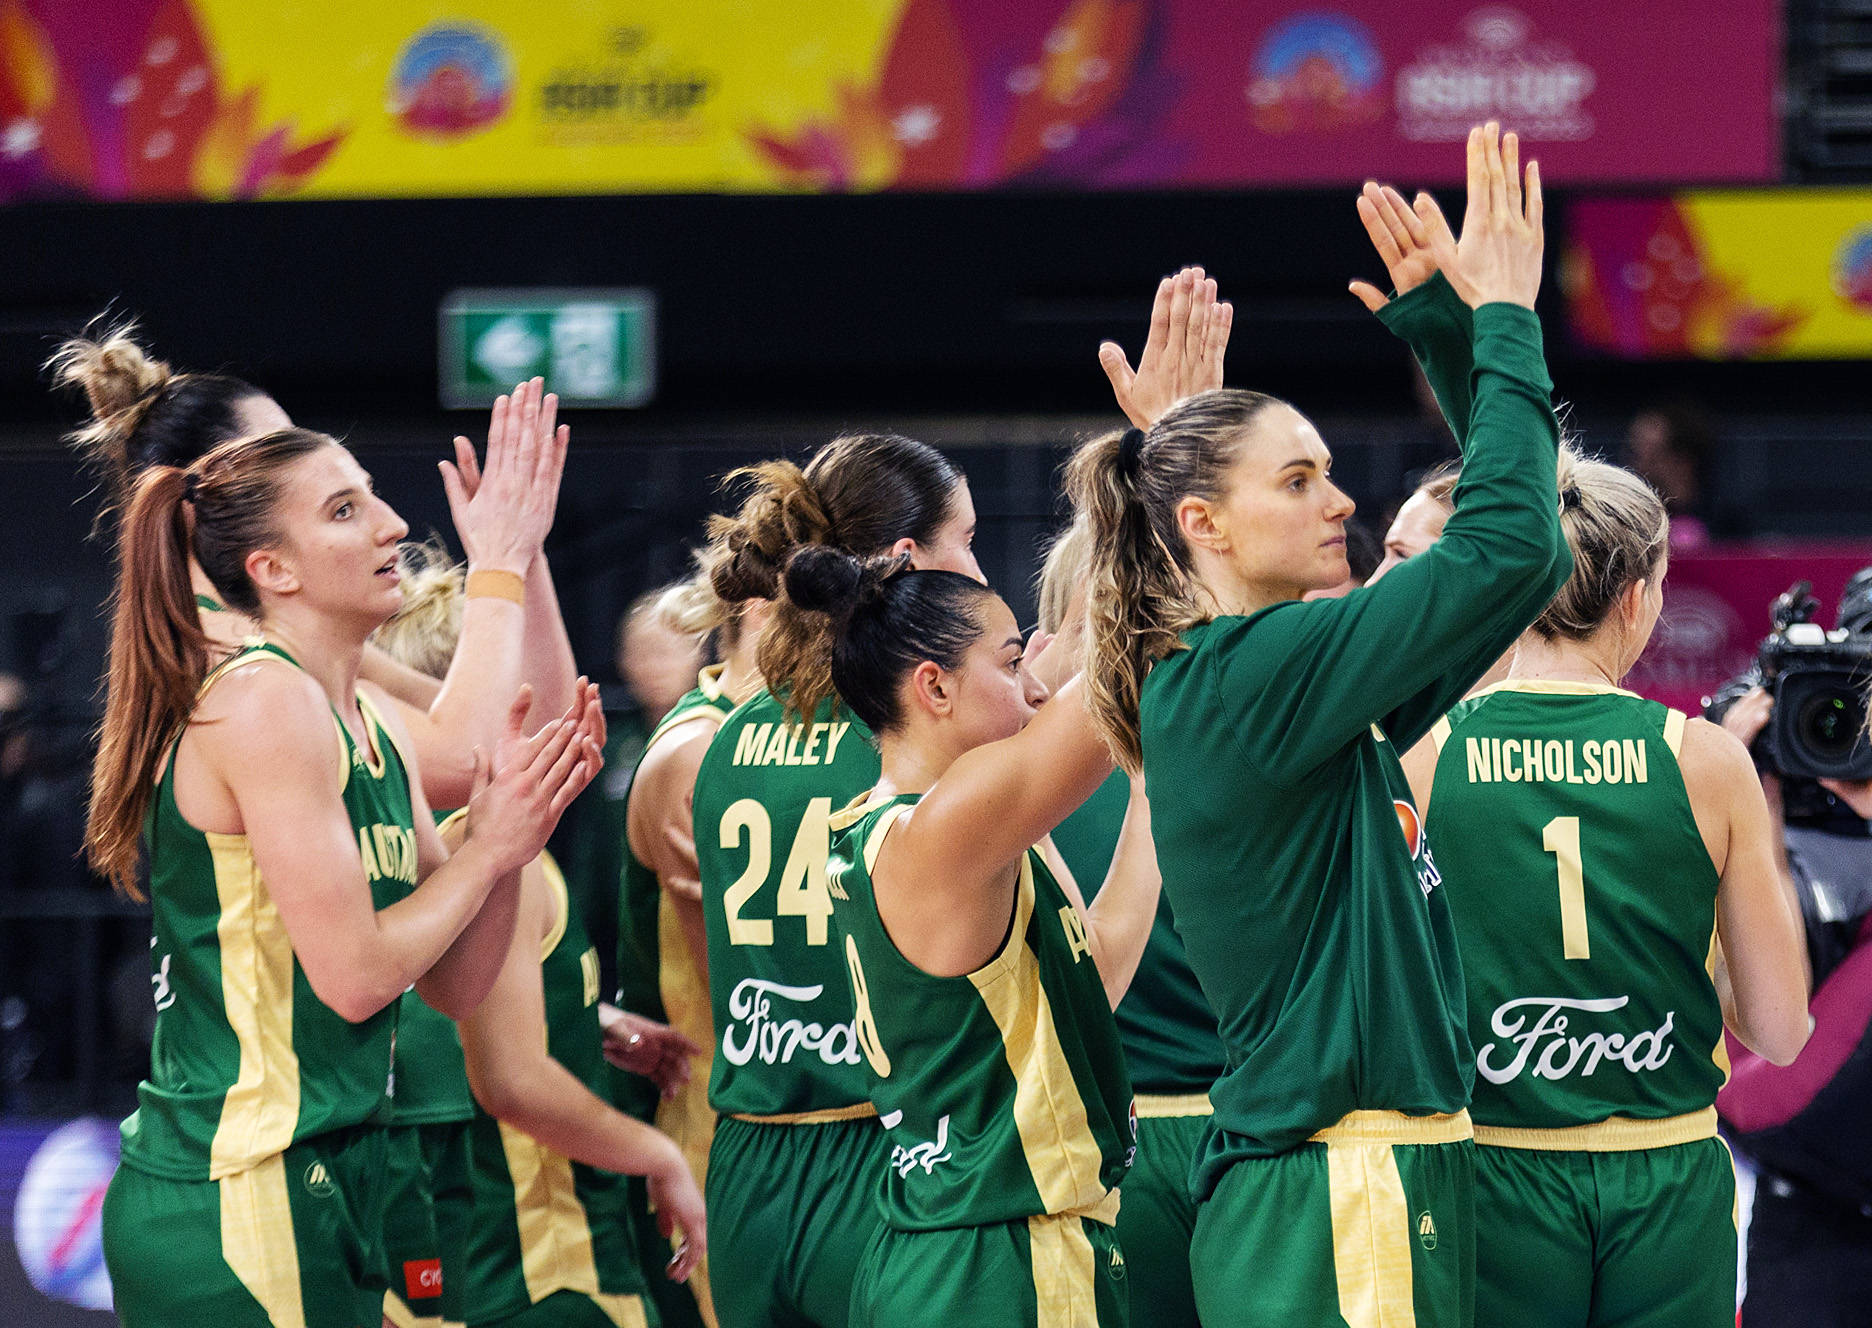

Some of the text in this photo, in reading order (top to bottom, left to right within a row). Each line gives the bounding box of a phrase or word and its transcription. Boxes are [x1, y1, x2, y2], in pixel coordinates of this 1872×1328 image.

[732, 722, 850, 766] MALEY
[1466, 737, 1648, 784] NICHOLSON
[719, 797, 833, 946] 24
[1543, 816, 1590, 960] 1
[722, 978, 862, 1066] Ford
[1477, 995, 1675, 1084] Ford
